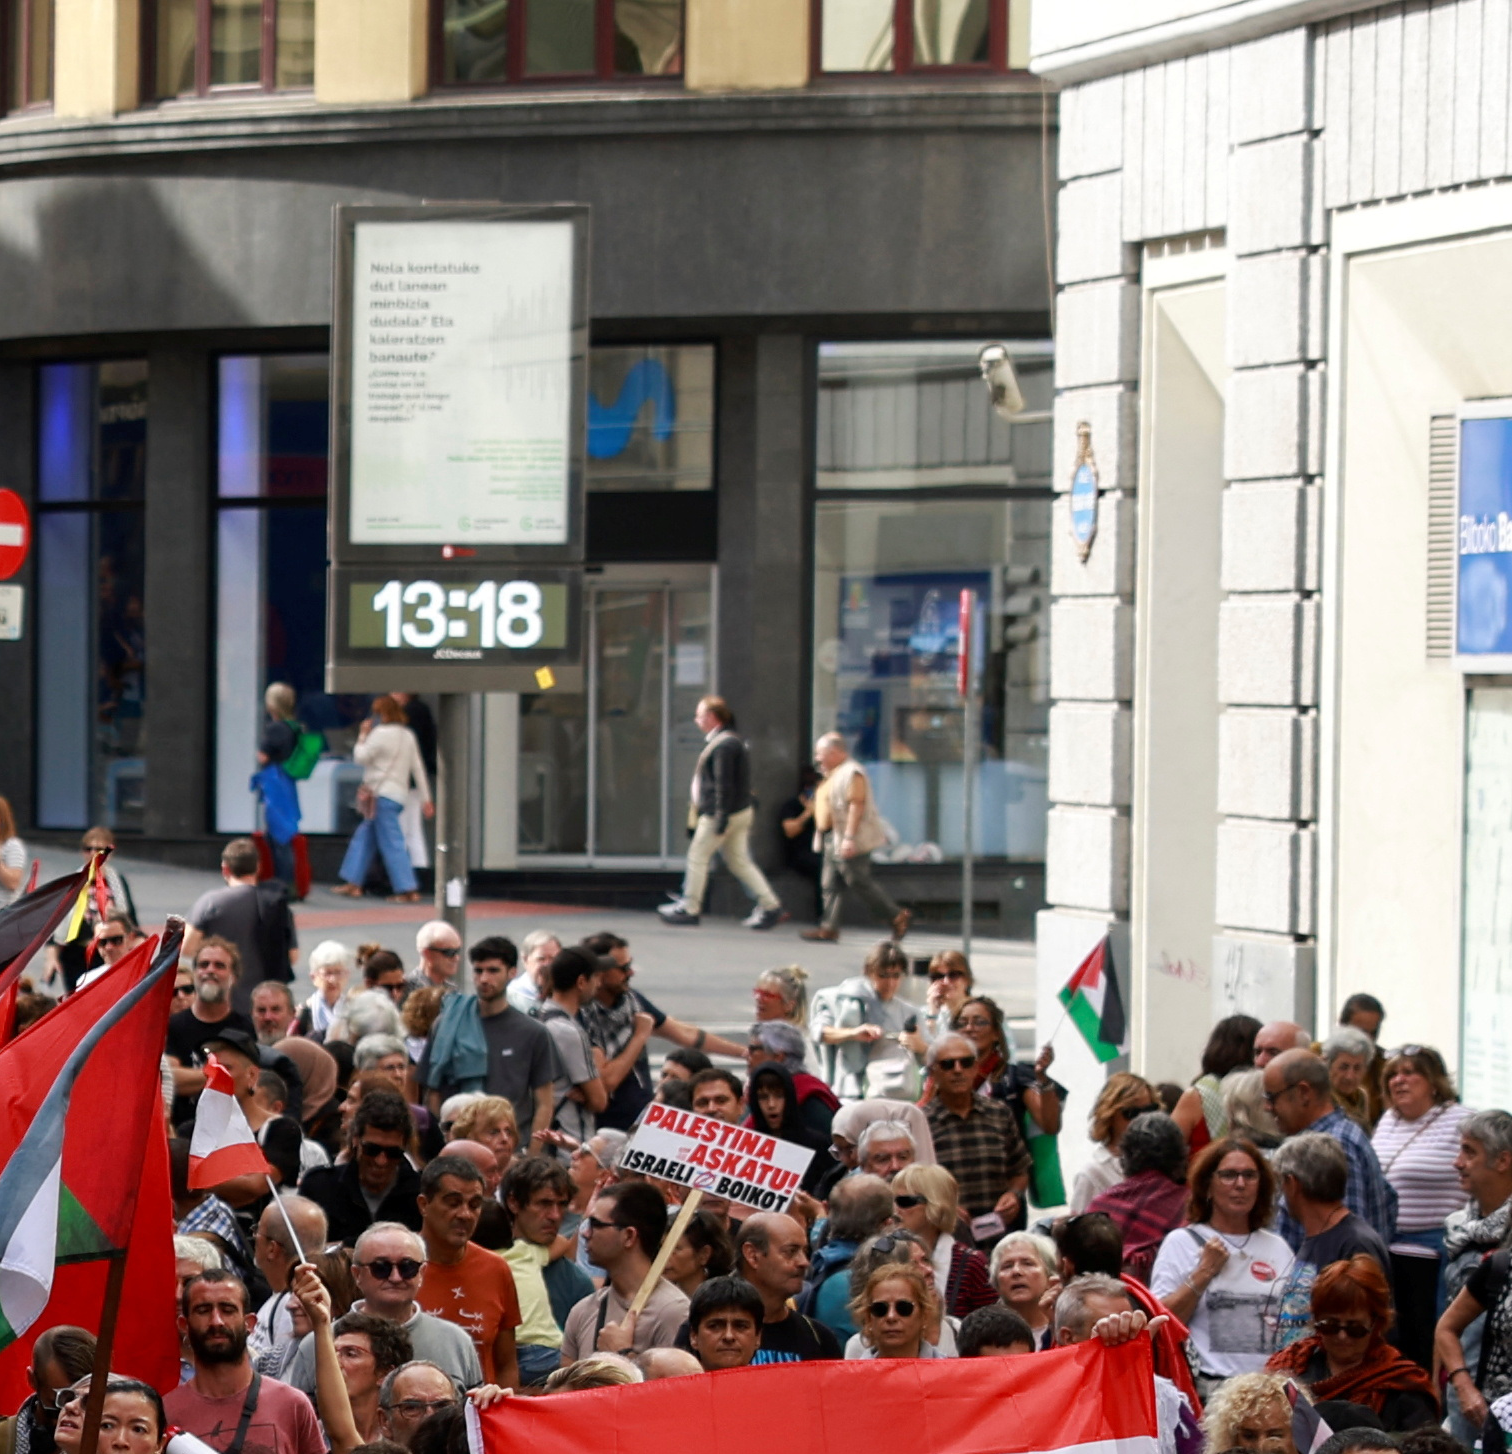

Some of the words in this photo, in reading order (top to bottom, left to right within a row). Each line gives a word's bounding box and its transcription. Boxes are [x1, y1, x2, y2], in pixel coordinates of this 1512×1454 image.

[373, 580, 543, 649] 13:18
[644, 1104, 777, 1161] PALESTINA
[623, 1149, 695, 1184] ISRAELI
[715, 1177, 789, 1212] BOIKOT
[686, 1144, 801, 1195] ASKATU!
